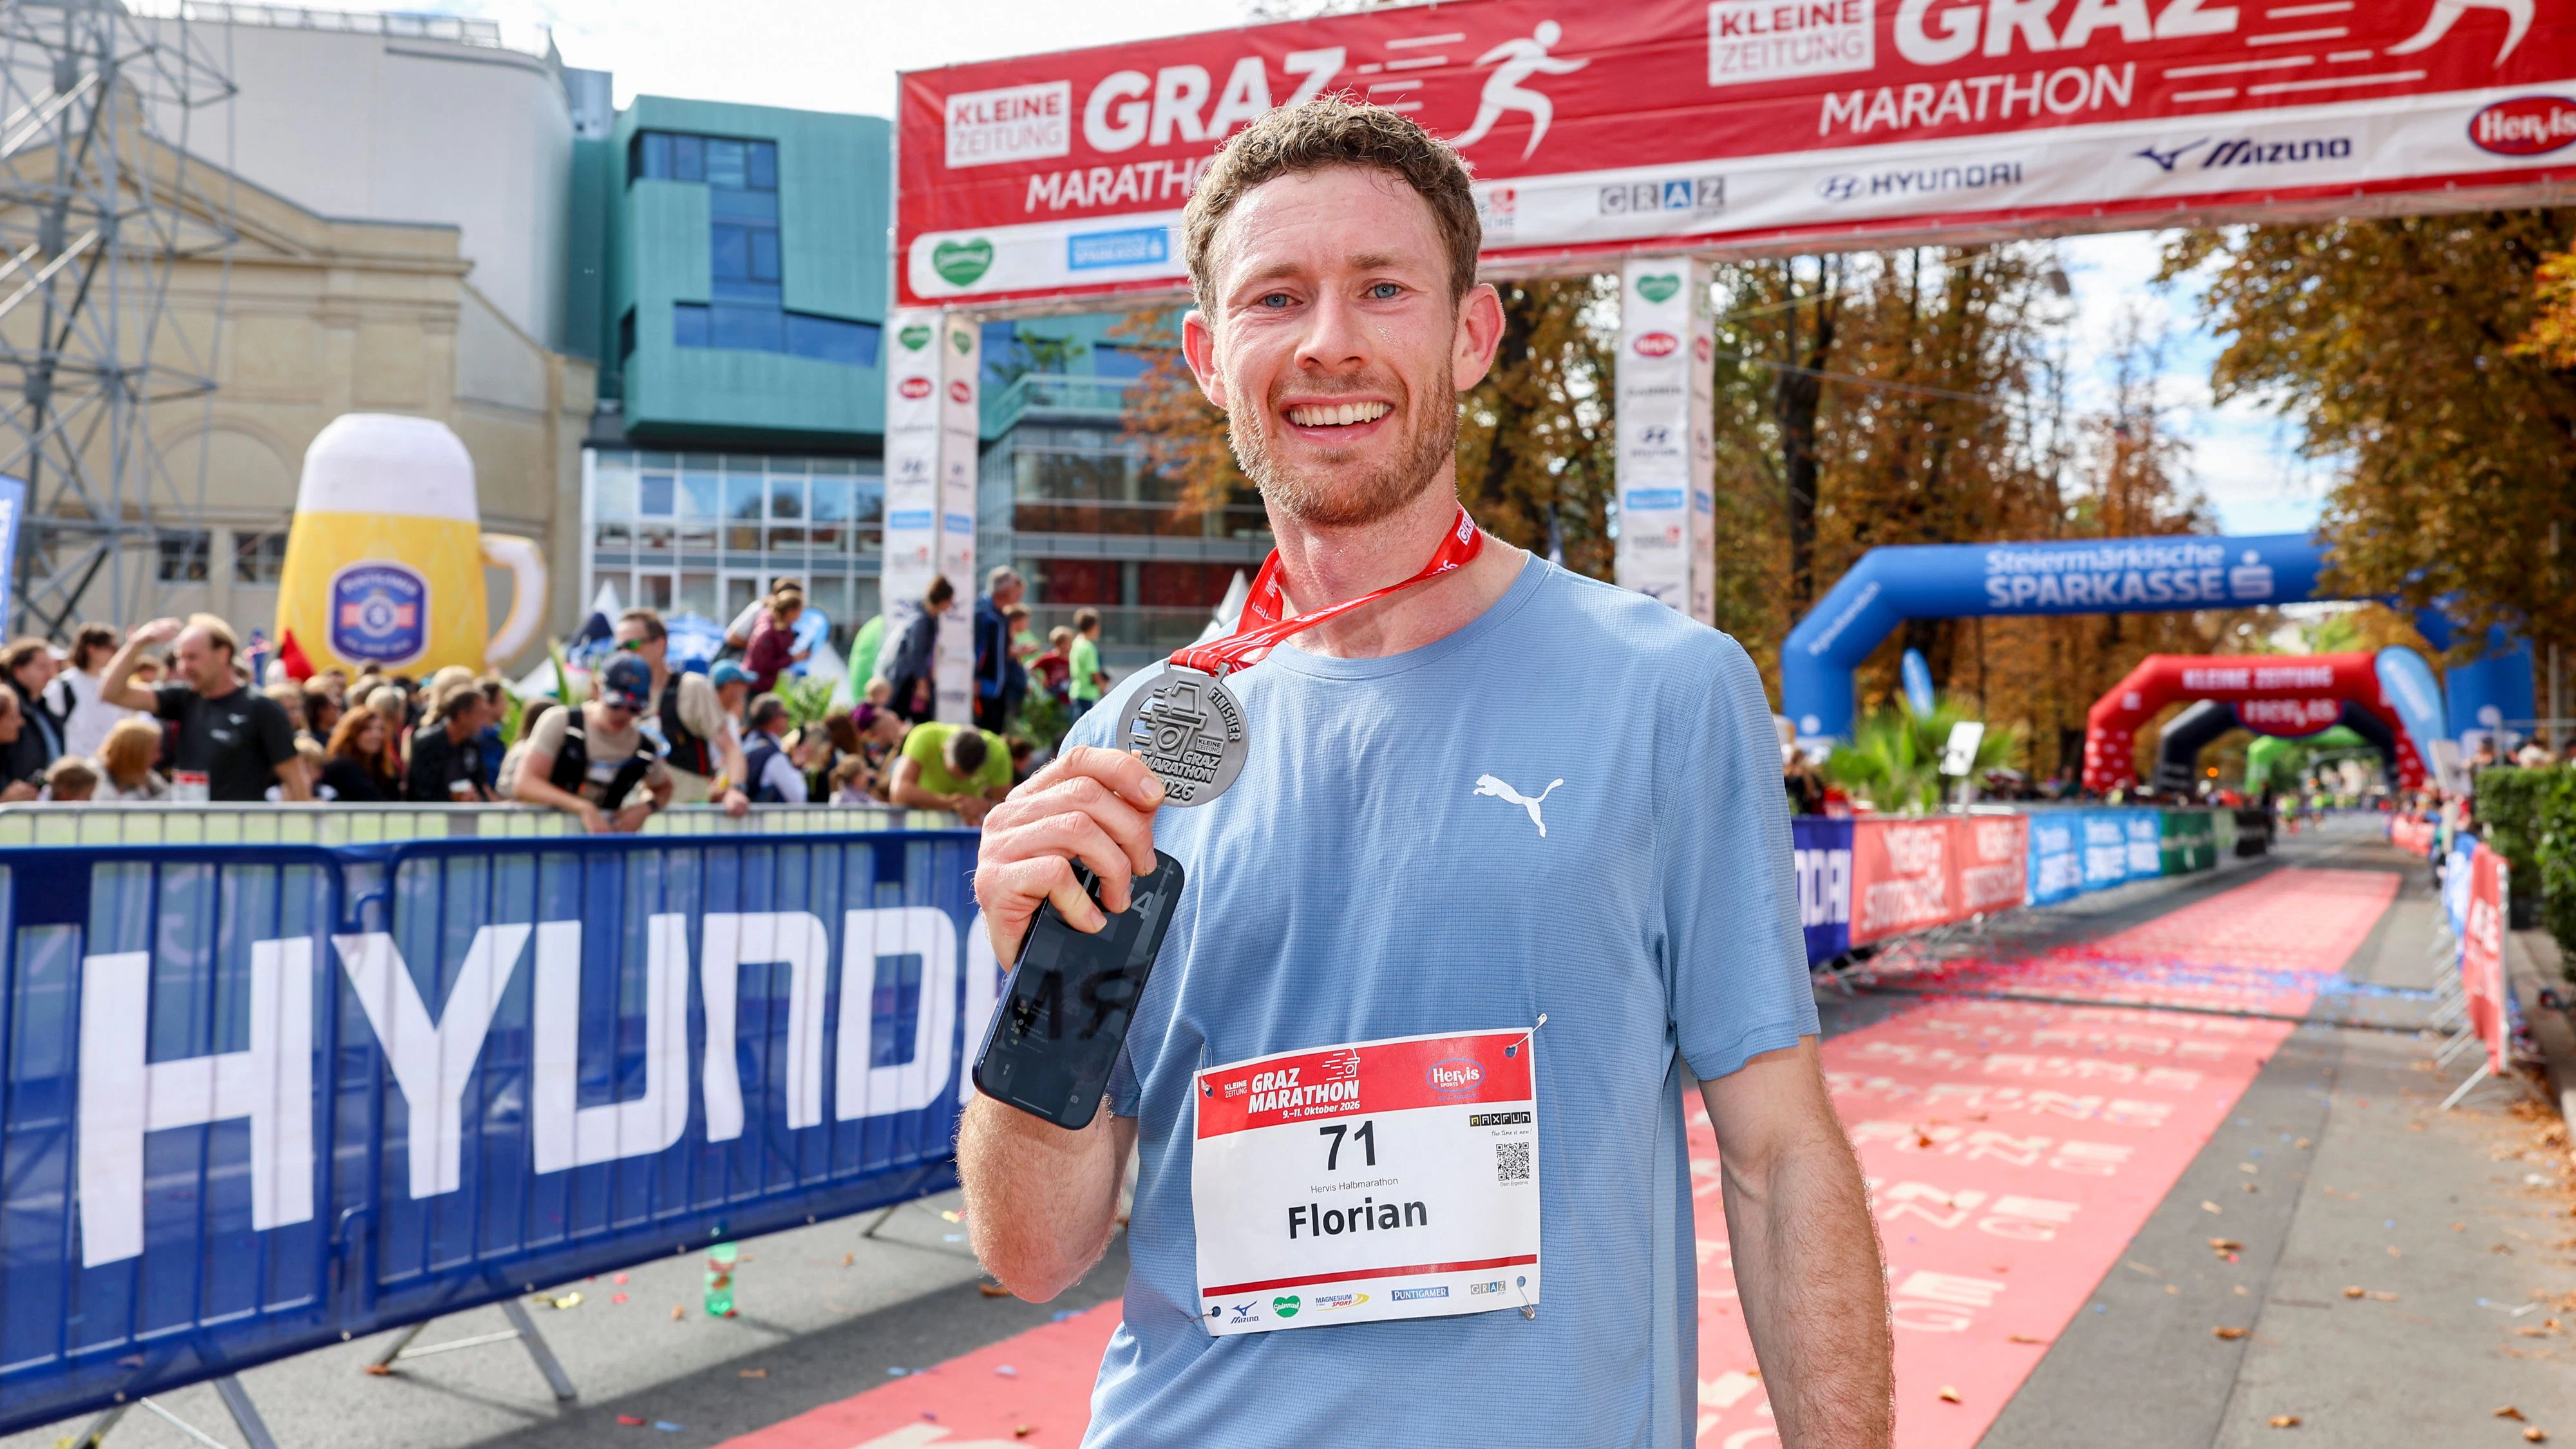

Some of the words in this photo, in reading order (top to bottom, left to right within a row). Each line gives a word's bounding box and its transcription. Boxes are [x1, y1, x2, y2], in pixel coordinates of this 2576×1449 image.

[1719, 0, 1863, 37] KLEINE
[1719, 31, 1864, 74] ZEITUNG
[954, 93, 1062, 126] KLEINE
[1083, 46, 1347, 153] GRAZ
[1819, 62, 2135, 137] MARATHON
[954, 122, 1063, 158] ZEITUNG
[2202, 138, 2351, 169] MIZUNO
[1025, 155, 1216, 213] MARATH
[1871, 162, 2022, 196] HYUNDAI
[1600, 176, 1725, 216] GRAZ
[1985, 545, 2224, 575] Steiermärkische
[1985, 567, 2226, 608] SPARKASSE
[1208, 687, 1242, 741] FINISHER
[1197, 744, 1221, 753] ZEITUNG
[1198, 739, 1221, 748] KLEINE
[1141, 754, 1216, 784] MARATHON
[1182, 751, 1222, 770] GRAZ
[1160, 778, 1196, 800] 026
[78, 907, 1009, 1268] HYUND
[1224, 1079, 1247, 1091] KLEINE
[1251, 1067, 1300, 1094] GRAZ
[1433, 1066, 1481, 1084] Hervis
[1225, 1086, 1247, 1099] ZEITUNG
[1248, 1079, 1360, 1114] MARATHON
[1304, 1104, 1339, 1116] Oktober
[1340, 1100, 1361, 1112] 2026
[1470, 1112, 1531, 1126] MAXFUN
[1319, 1120, 1376, 1171] 71
[1311, 1183, 1337, 1193] Hervis
[1338, 1177, 1398, 1191] Halbmarathon
[1289, 1197, 1428, 1240] Florian
[1315, 1293, 1352, 1303] MAGNESIUM
[1394, 1287, 1446, 1300] PUNTIGAMER
[1470, 1280, 1506, 1295] GRAZ
[1332, 1300, 1352, 1308] SPORT
[1230, 1316, 1260, 1324] MIZUNO
